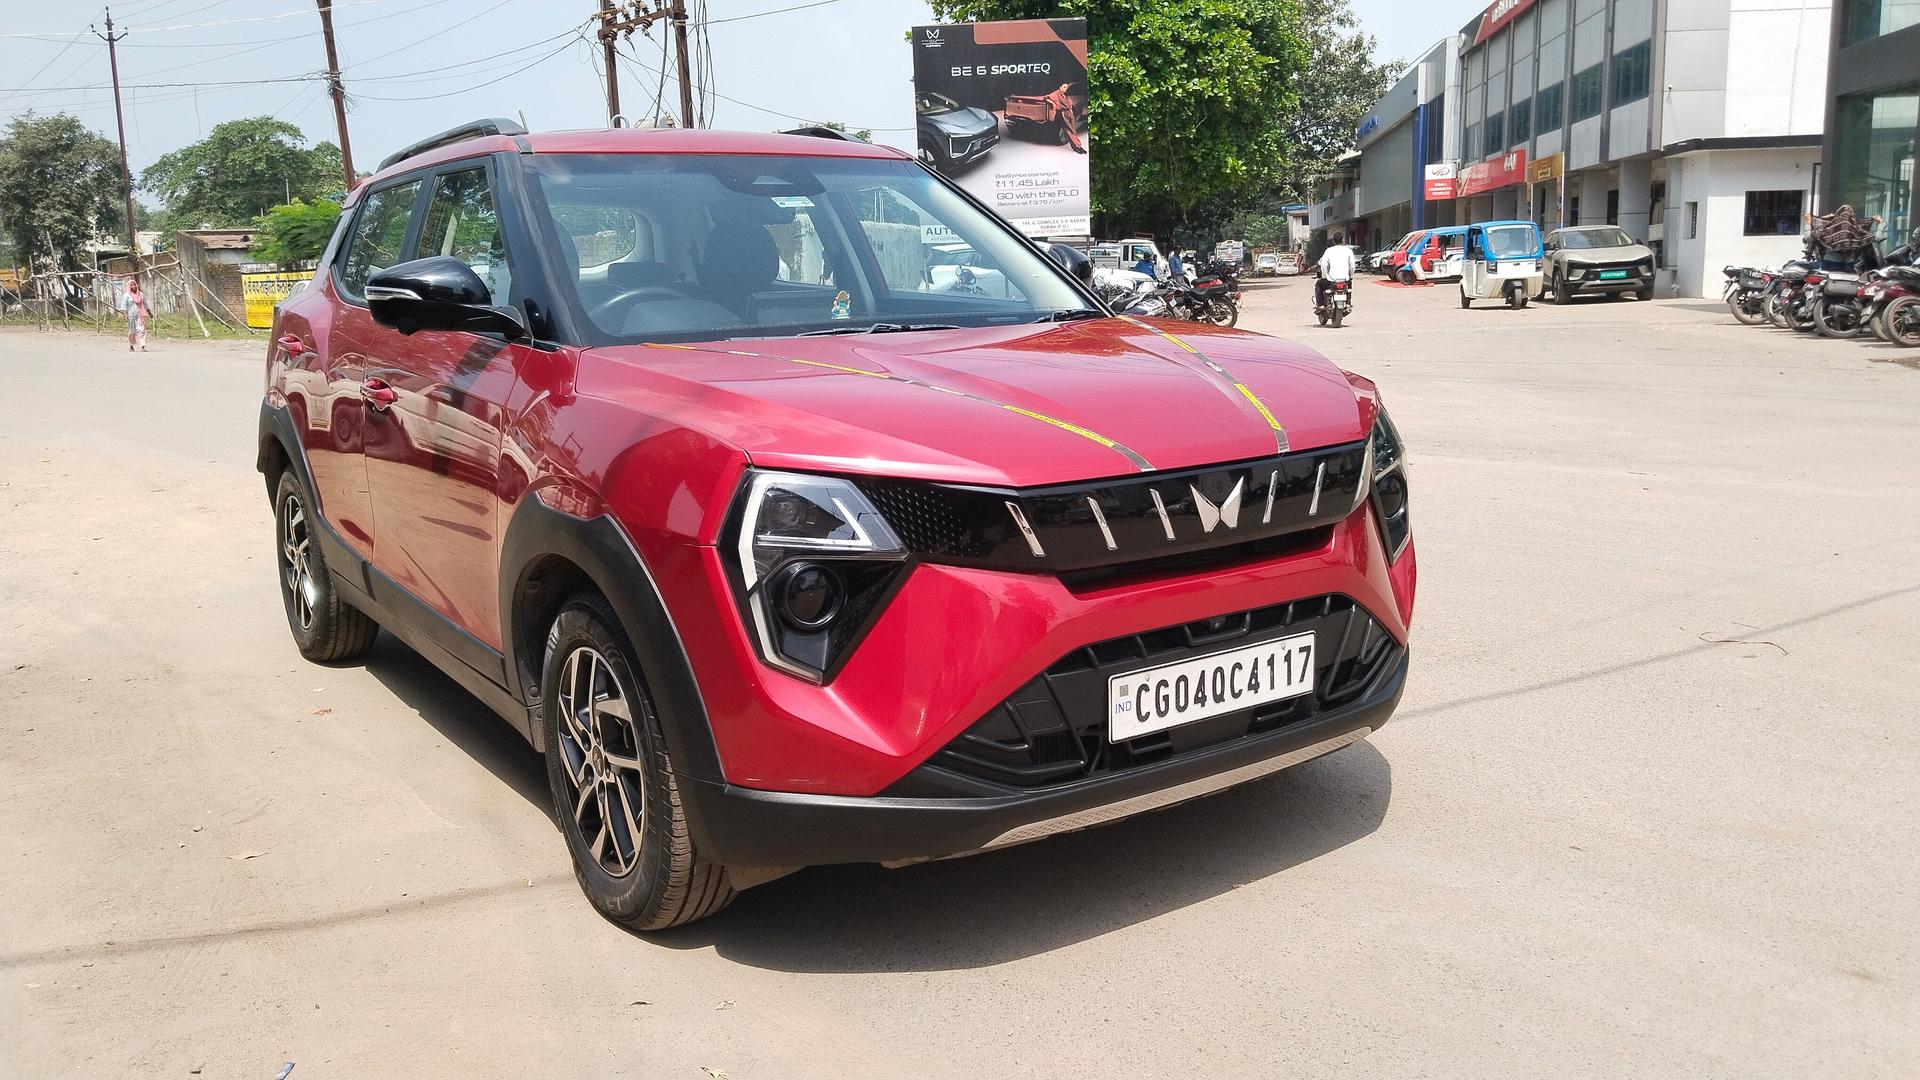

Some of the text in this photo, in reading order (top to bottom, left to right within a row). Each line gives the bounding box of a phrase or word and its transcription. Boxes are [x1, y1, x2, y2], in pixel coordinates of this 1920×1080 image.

[951, 63, 1051, 77] BE 6 SPORTEQ
[1035, 178, 1060, 187] Lakh
[996, 189, 1079, 200] GO with the FLO
[926, 227, 955, 236] AUT
[1115, 645, 1312, 723] IND CG04QC4117
